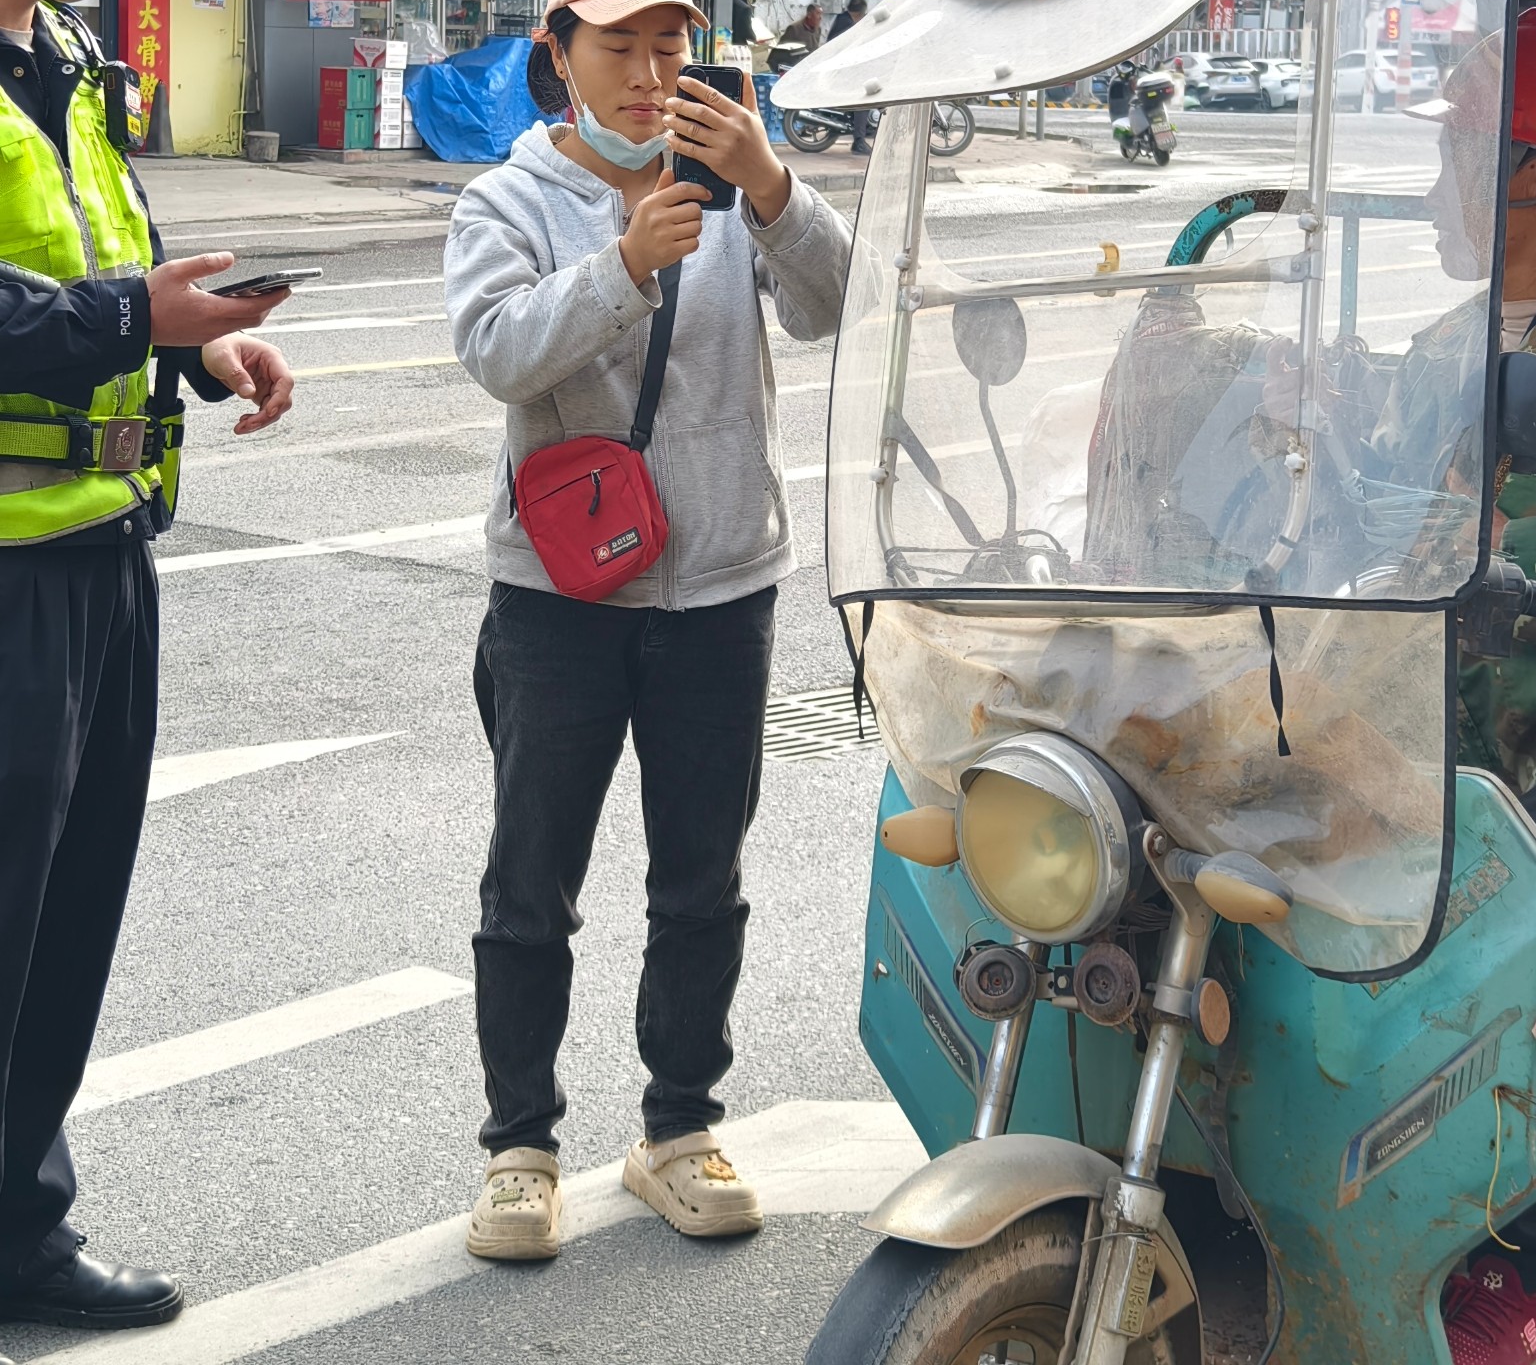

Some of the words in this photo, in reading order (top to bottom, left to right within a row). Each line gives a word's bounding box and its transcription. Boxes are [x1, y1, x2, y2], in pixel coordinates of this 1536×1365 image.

[119, 295, 132, 336] POLICE
[927, 1012, 967, 1067] ZONGSHEN
[1376, 1117, 1427, 1161] ZONGSHEN
